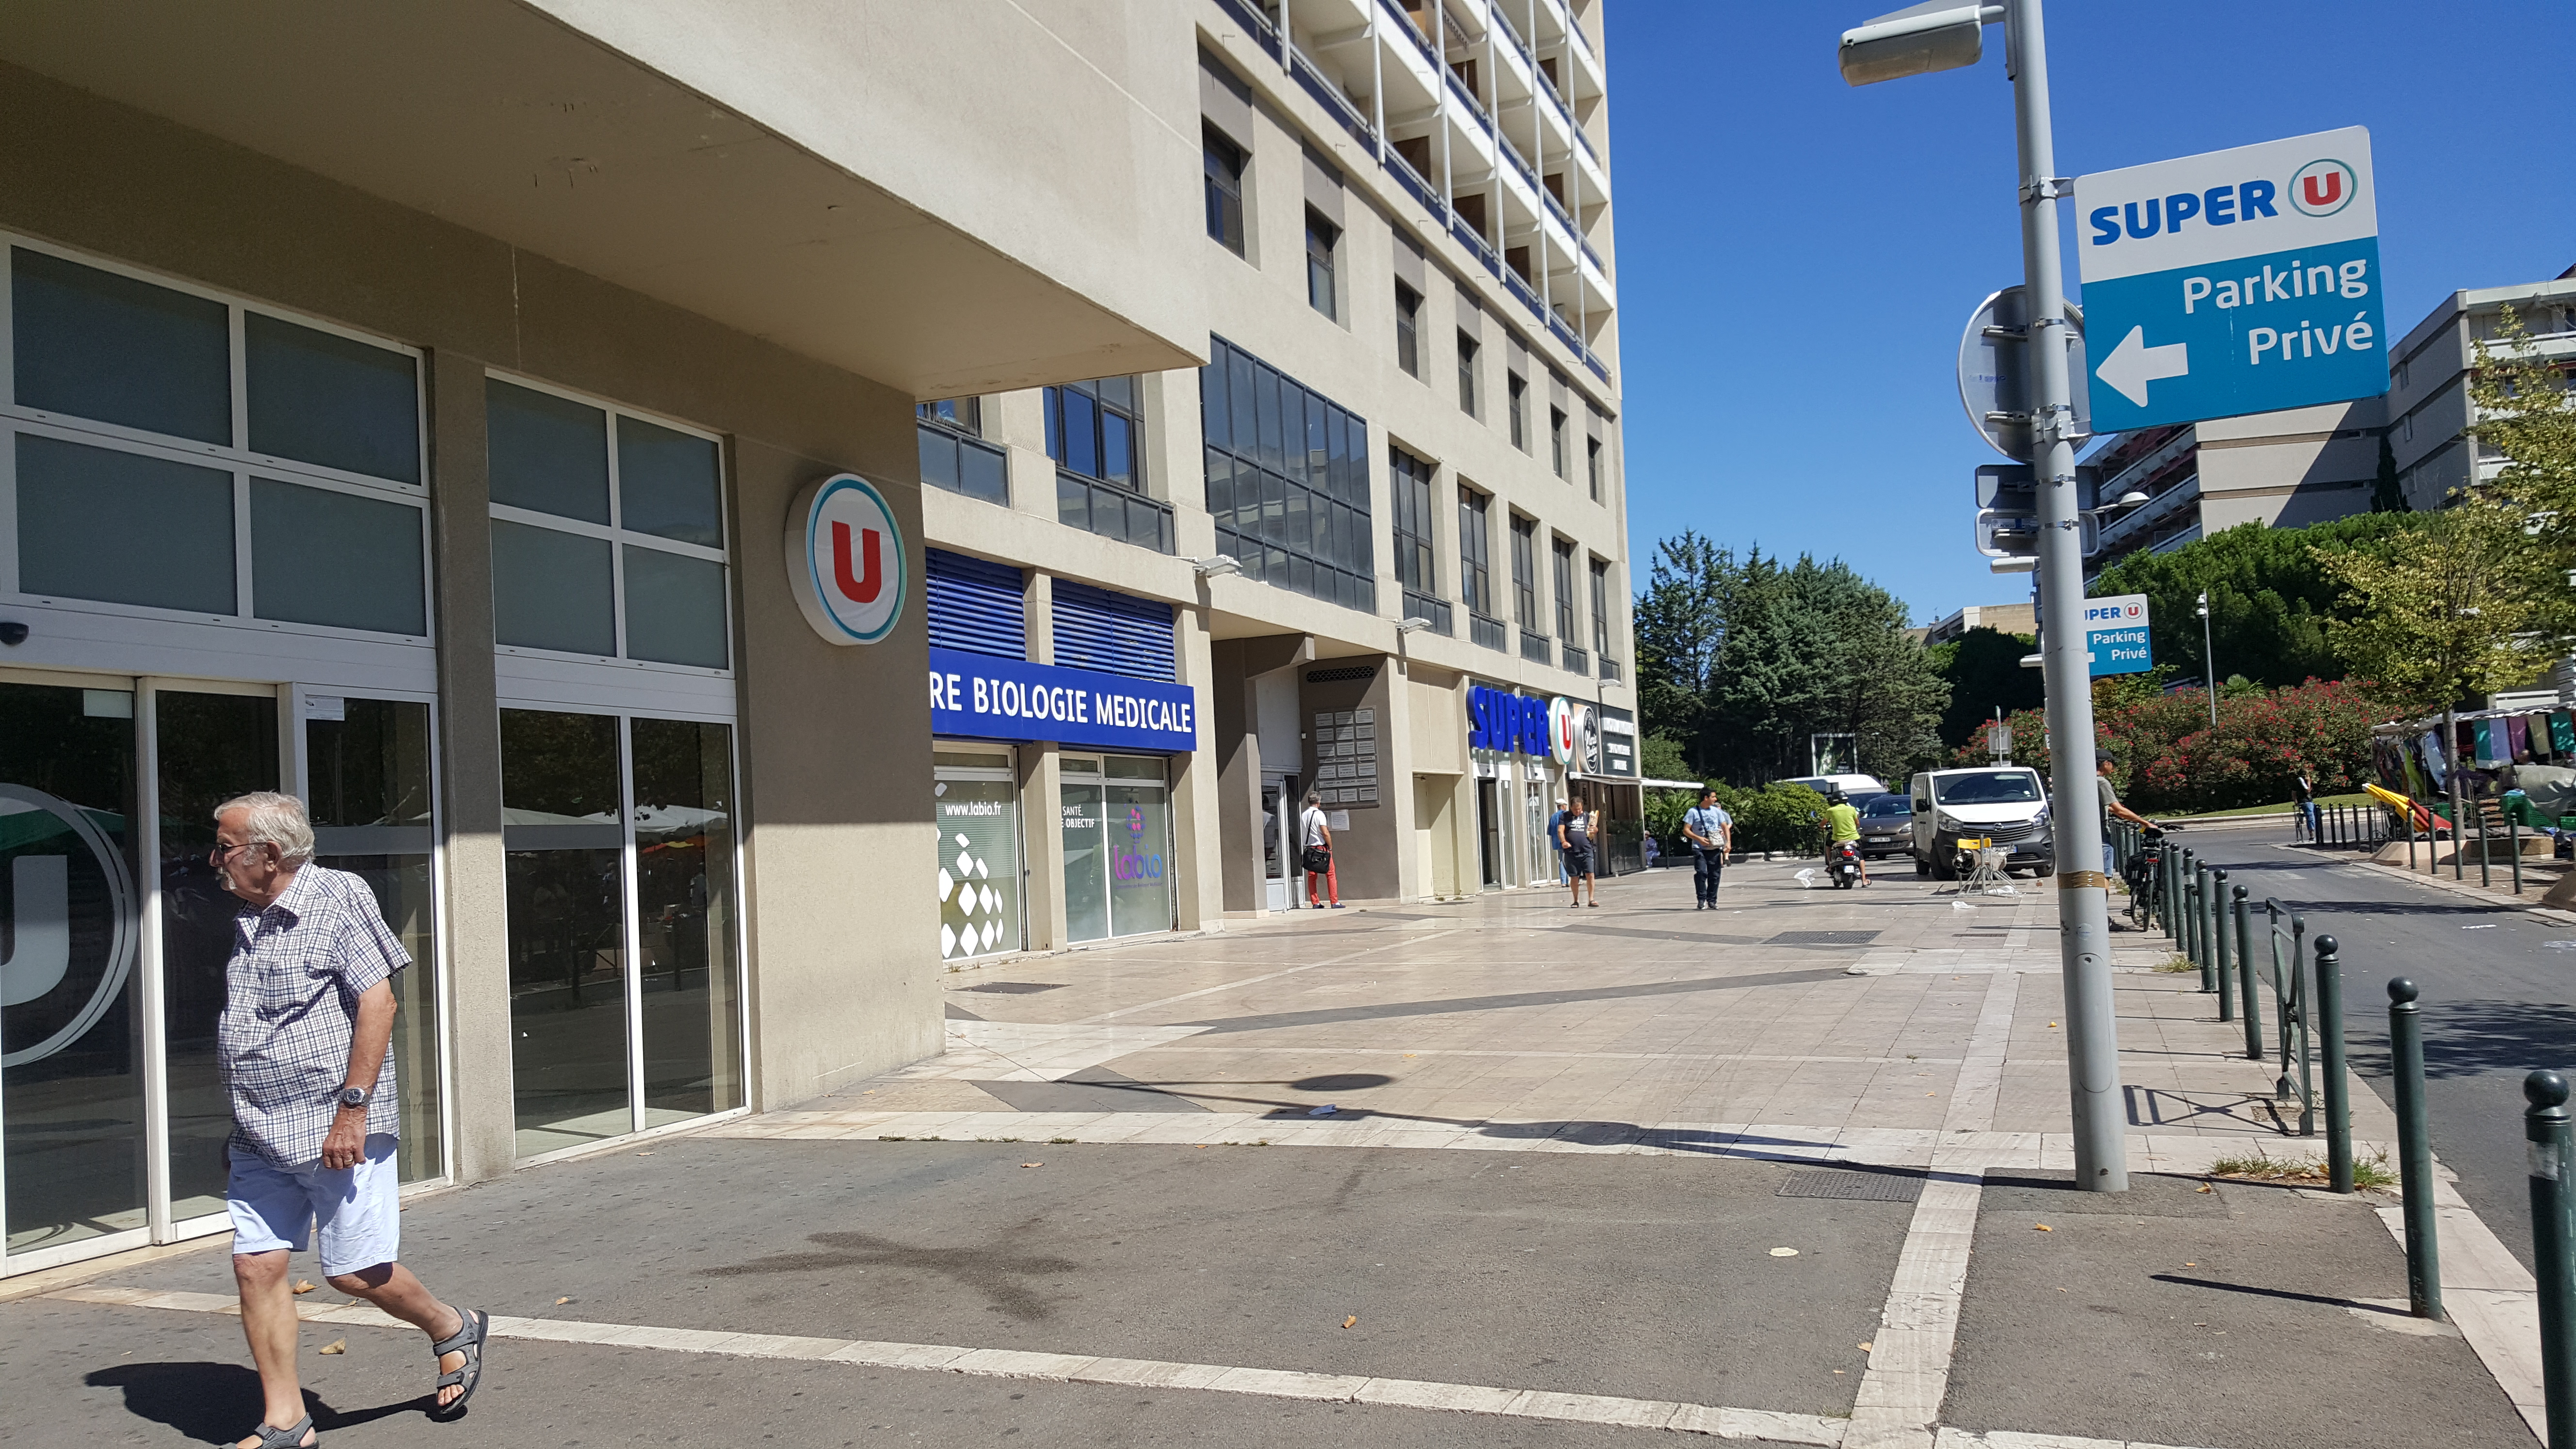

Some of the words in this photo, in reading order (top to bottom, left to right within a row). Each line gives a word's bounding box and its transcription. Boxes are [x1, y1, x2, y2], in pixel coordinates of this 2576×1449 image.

[2090, 179, 2279, 246] SUPER
[2303, 171, 2341, 206] U
[2183, 258, 2368, 315] Parking
[2248, 310, 2373, 365] Privé
[832, 520, 883, 604] U
[2084, 607, 2121, 621] PER
[2093, 630, 2146, 645] Parking
[2111, 646, 2147, 660] Privé
[973, 677, 1088, 723] BIOLOGIE
[1096, 692, 1192, 733] MEDICALE
[1466, 686, 1550, 757] SUPER
[945, 801, 1001, 816] www.labio.fr
[1063, 804, 1083, 816] SANTÉ.
[1066, 818, 1095, 828] OBJECTIF
[1113, 844, 1162, 880] labio
